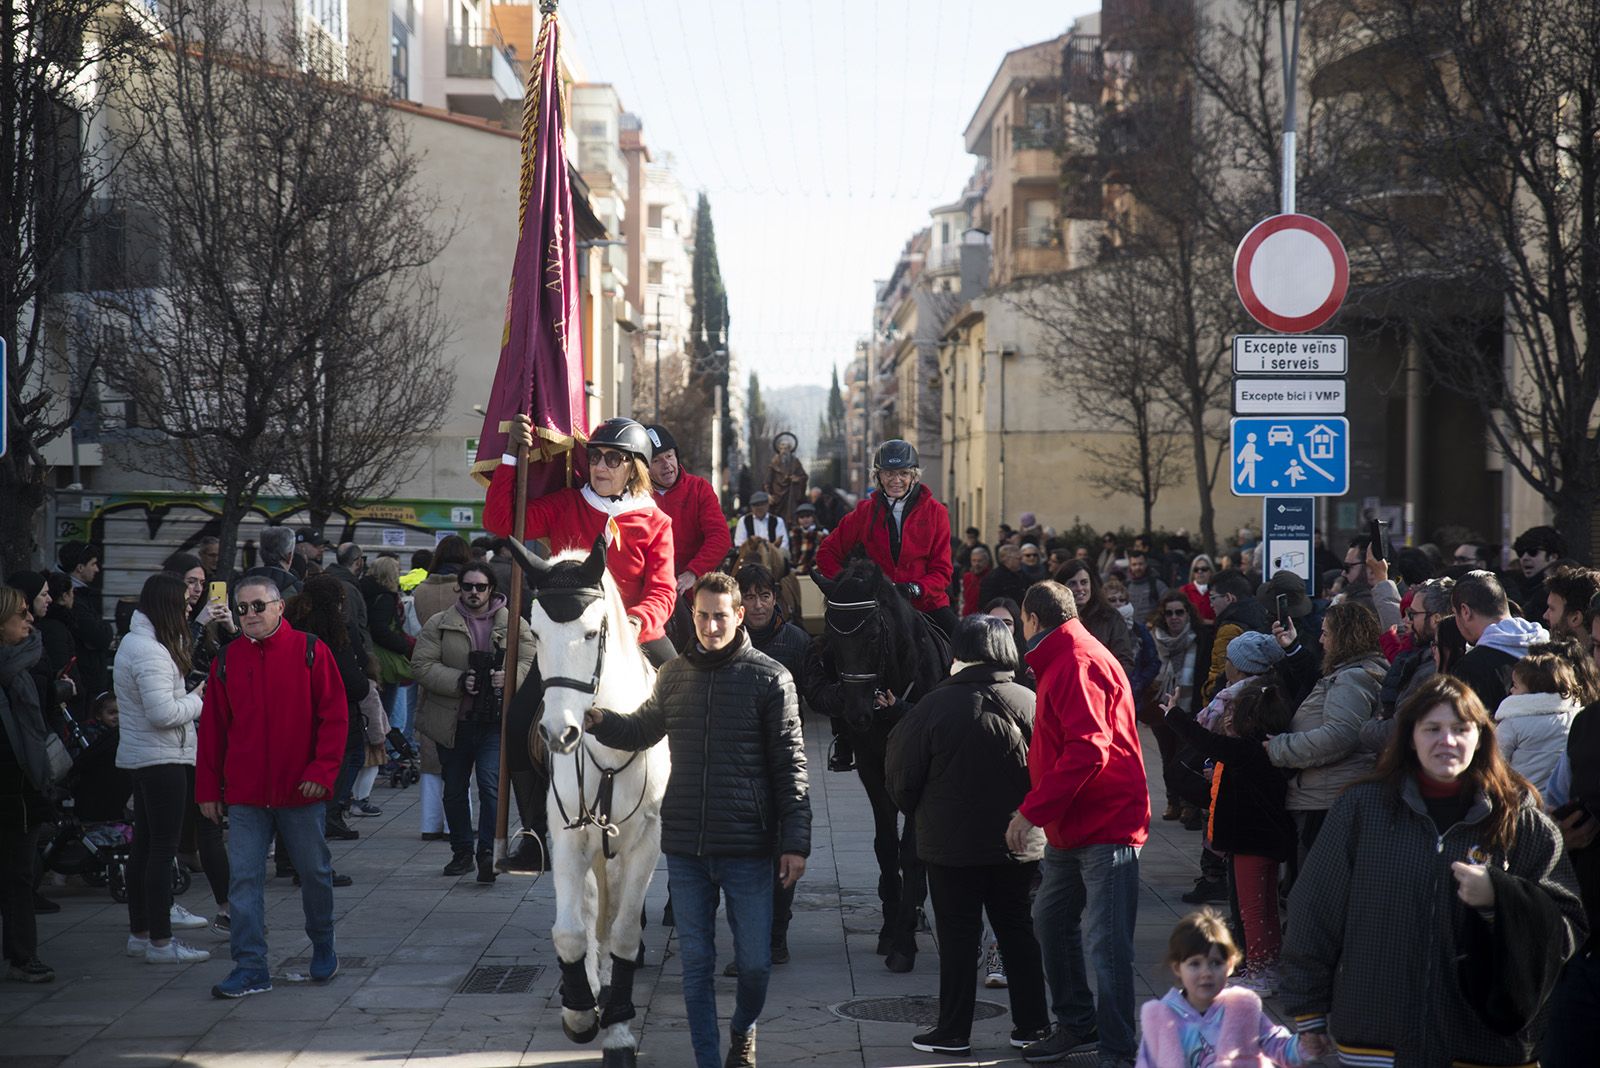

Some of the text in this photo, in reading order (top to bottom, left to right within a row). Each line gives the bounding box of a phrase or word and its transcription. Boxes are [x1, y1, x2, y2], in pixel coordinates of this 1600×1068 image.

[1244, 340, 1337, 356] Excepte veïns
[1261, 356, 1319, 369] i serveis
[1241, 391, 1341, 402] Excepte bici i VMP
